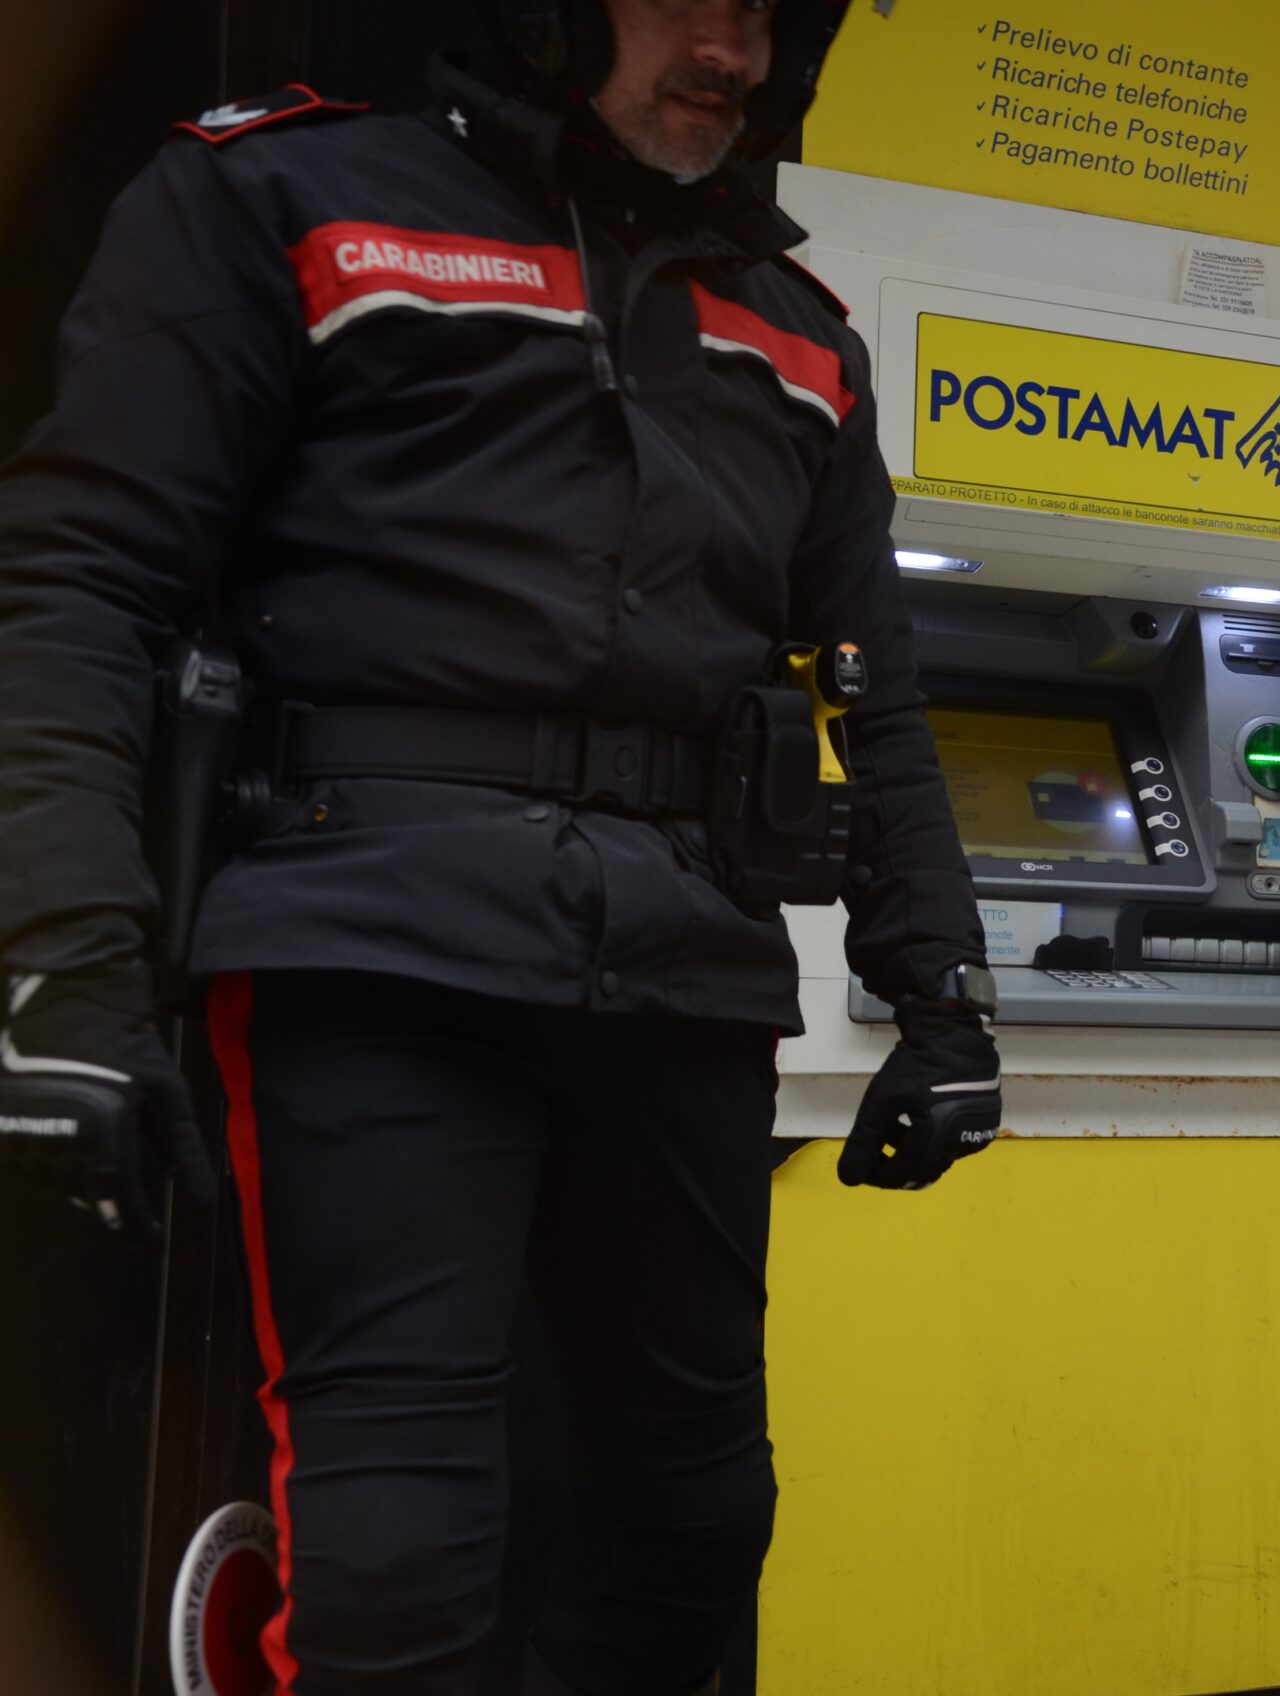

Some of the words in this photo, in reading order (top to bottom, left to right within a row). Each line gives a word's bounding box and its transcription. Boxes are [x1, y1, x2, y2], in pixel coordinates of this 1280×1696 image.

[992, 19, 1099, 60] Prelievo
[1107, 44, 1133, 66] di
[1139, 54, 1250, 88] contante
[992, 57, 1107, 99] Ricariche
[1115, 82, 1248, 124] telefoniche
[991, 94, 1118, 137] Ricariche
[1126, 118, 1249, 164] Postepay
[991, 131, 1135, 176] Pagamento
[1143, 157, 1249, 196] bollettini
[335, 239, 545, 288] CARABINIERI
[929, 368, 1235, 460] POSTAMAT
[890, 479, 946, 496] PPARATO
[949, 485, 1017, 504] PROTETTO
[1027, 495, 1038, 506] In
[1040, 499, 1066, 511] caso
[1069, 500, 1079, 511] di
[1081, 501, 1120, 516] attacco
[1122, 507, 1132, 518] le
[1134, 509, 1189, 525] banconote
[1192, 517, 1233, 530] saranno
